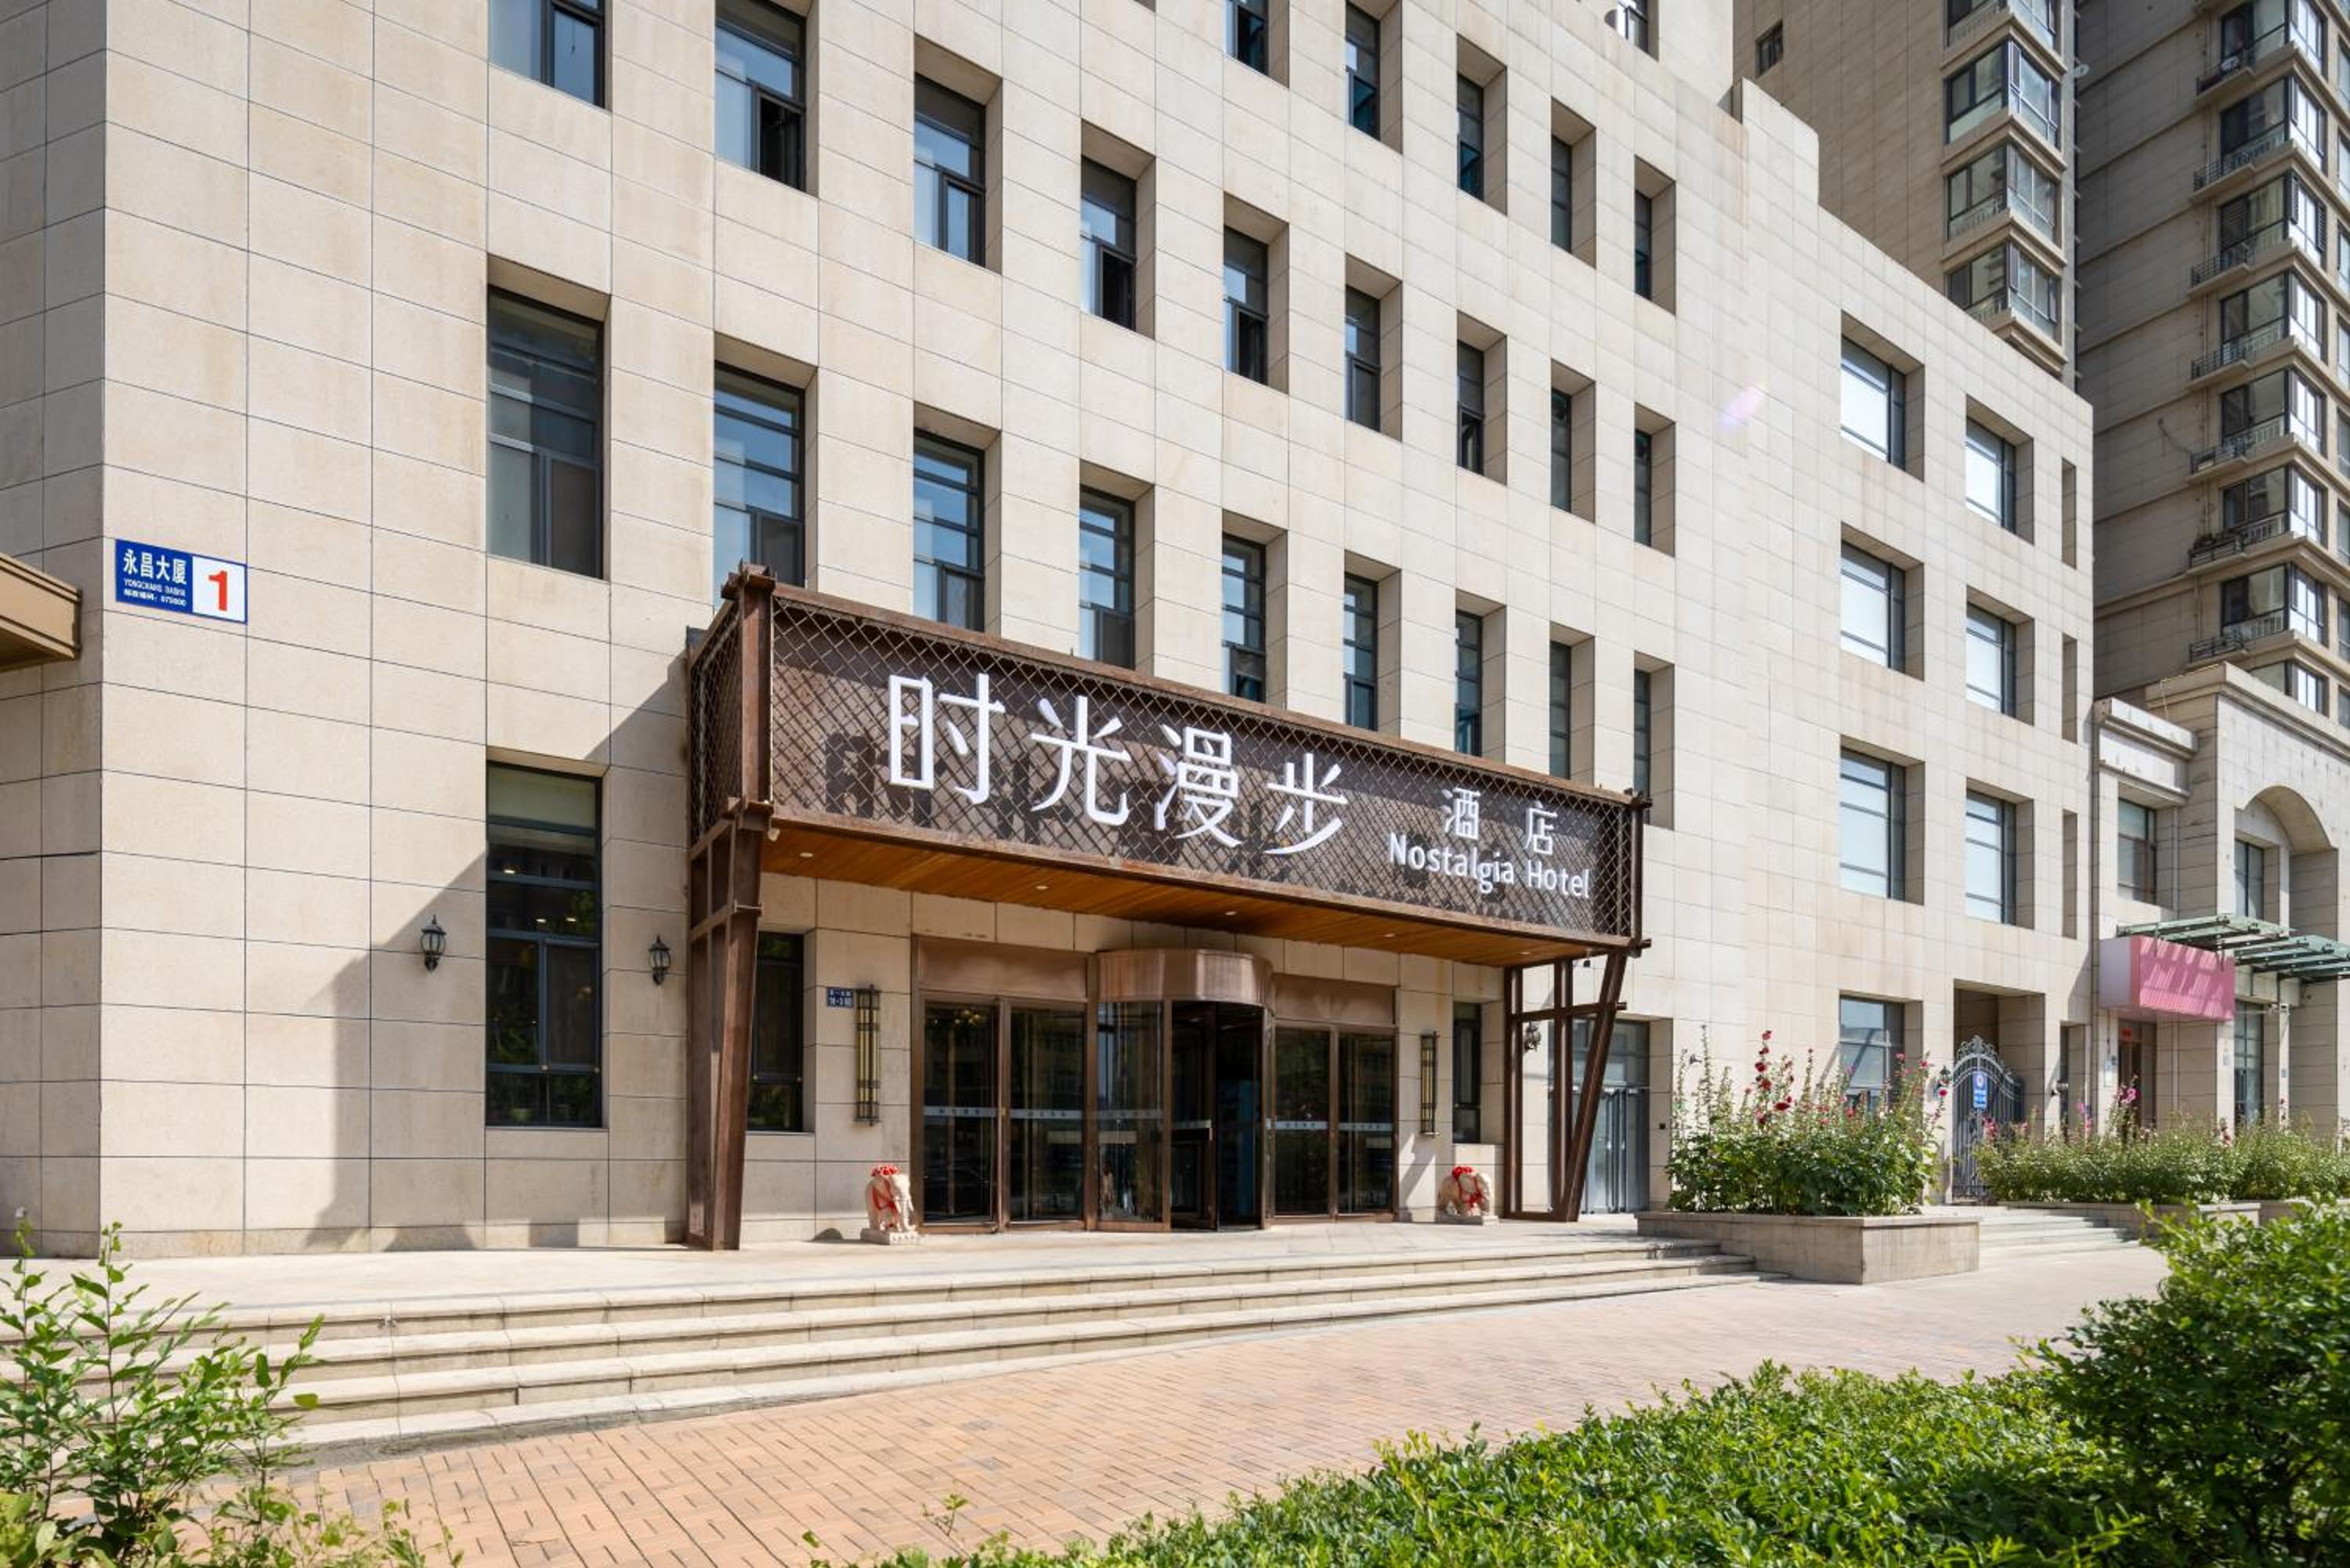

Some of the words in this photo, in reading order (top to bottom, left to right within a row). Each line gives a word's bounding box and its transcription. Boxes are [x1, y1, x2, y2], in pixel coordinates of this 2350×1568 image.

[123, 548, 187, 585] 永昌大厦
[208, 570, 228, 612] 1
[888, 673, 1348, 855] 时光漫步
[1441, 786, 1558, 855] 酒店
[1390, 832, 1515, 894] Nostalgia
[1528, 858, 1590, 899] Hotel
